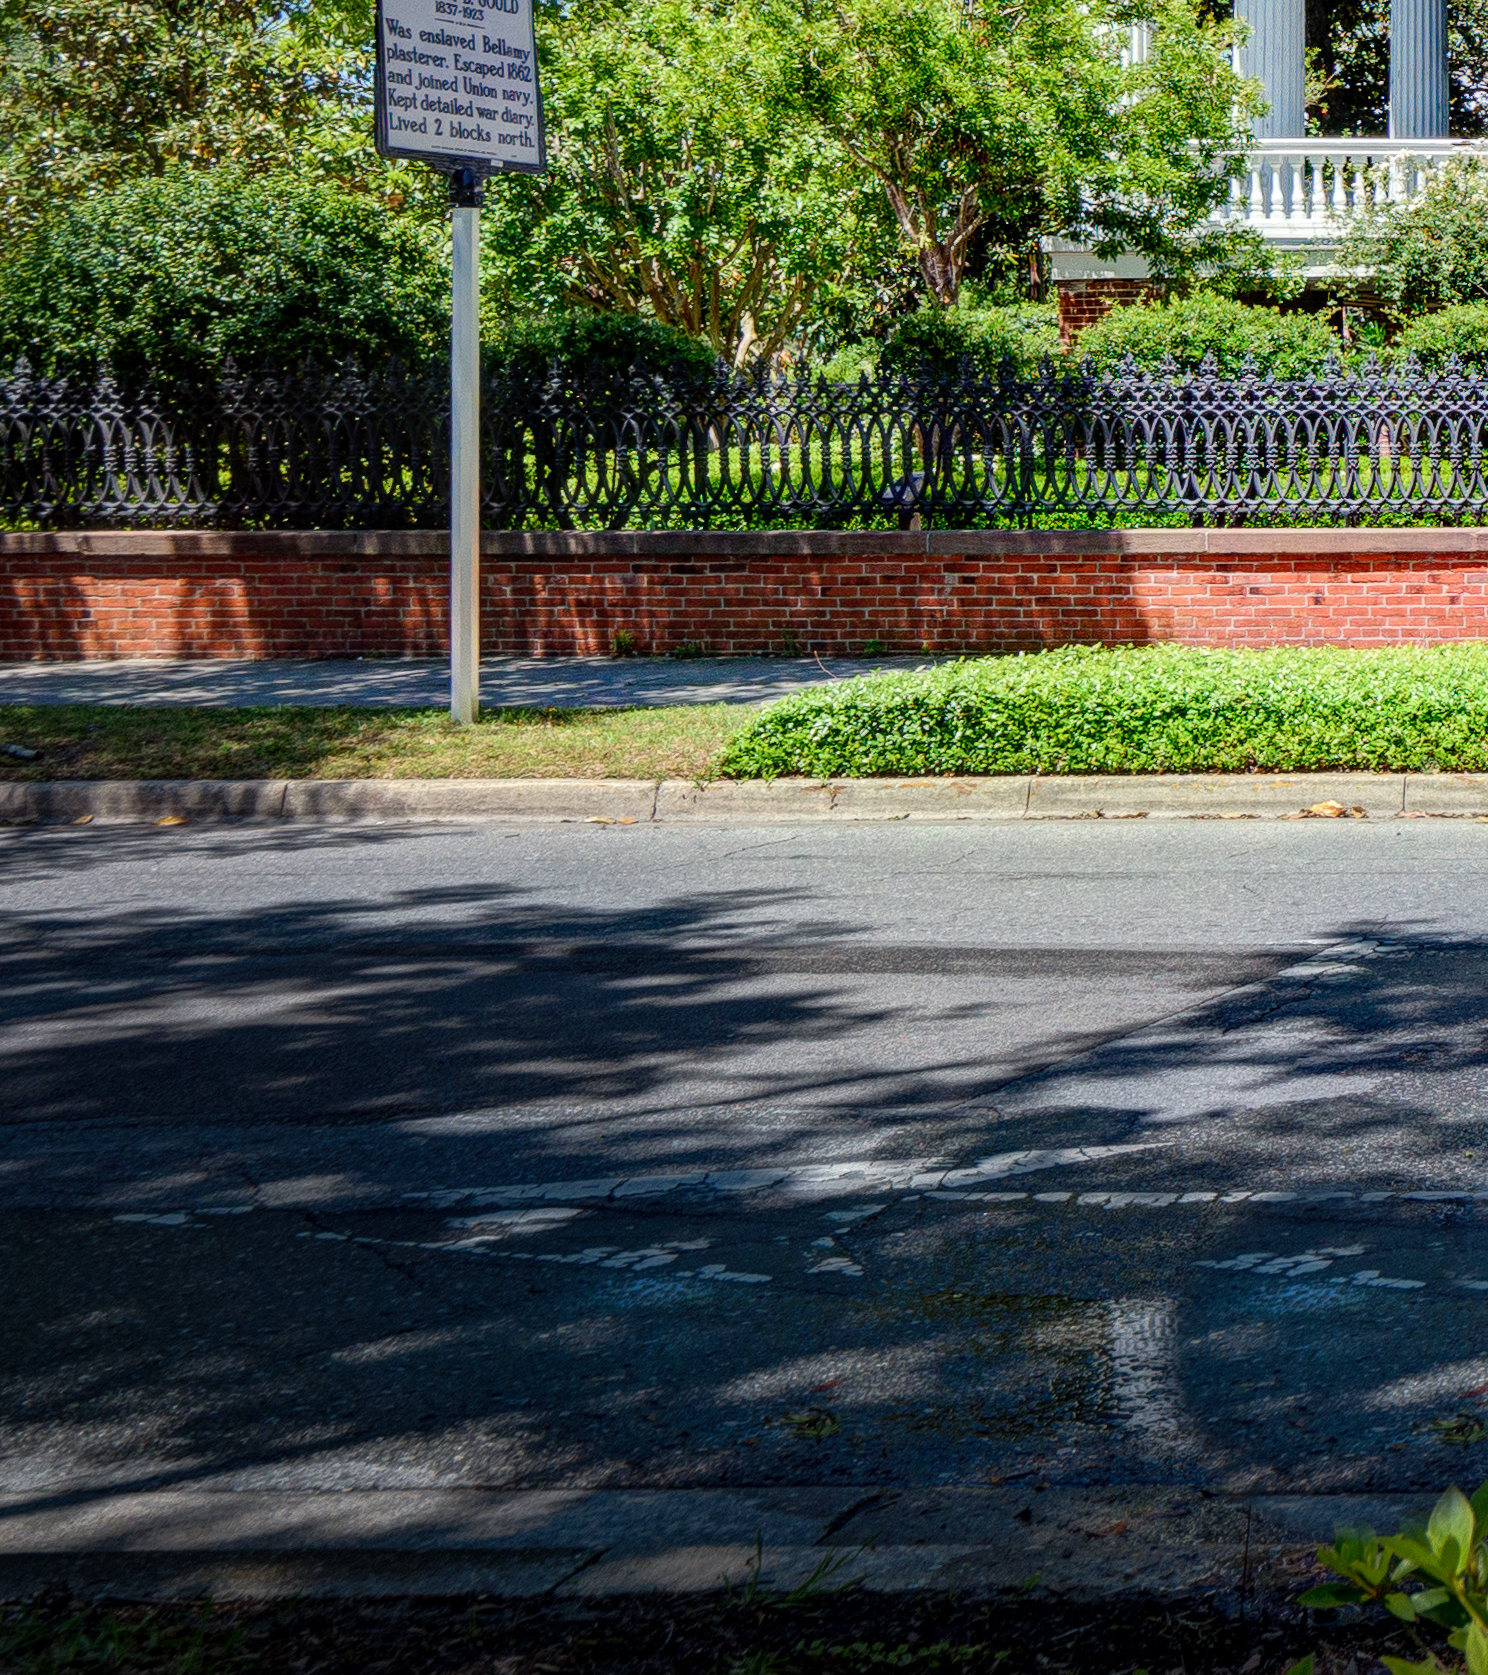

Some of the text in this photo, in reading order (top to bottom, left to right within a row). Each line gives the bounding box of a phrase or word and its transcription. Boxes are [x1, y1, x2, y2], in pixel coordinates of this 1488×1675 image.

[435, 0, 485, 21] 1837-1923
[385, 17, 531, 64] Was enslaved Bellamy
[387, 43, 532, 82] plasterer. Escaped 1862
[388, 68, 534, 107] and joined Union navy.
[388, 88, 535, 129] Kept detailed war diary.
[389, 112, 535, 148] Lived 2 blocks north.
